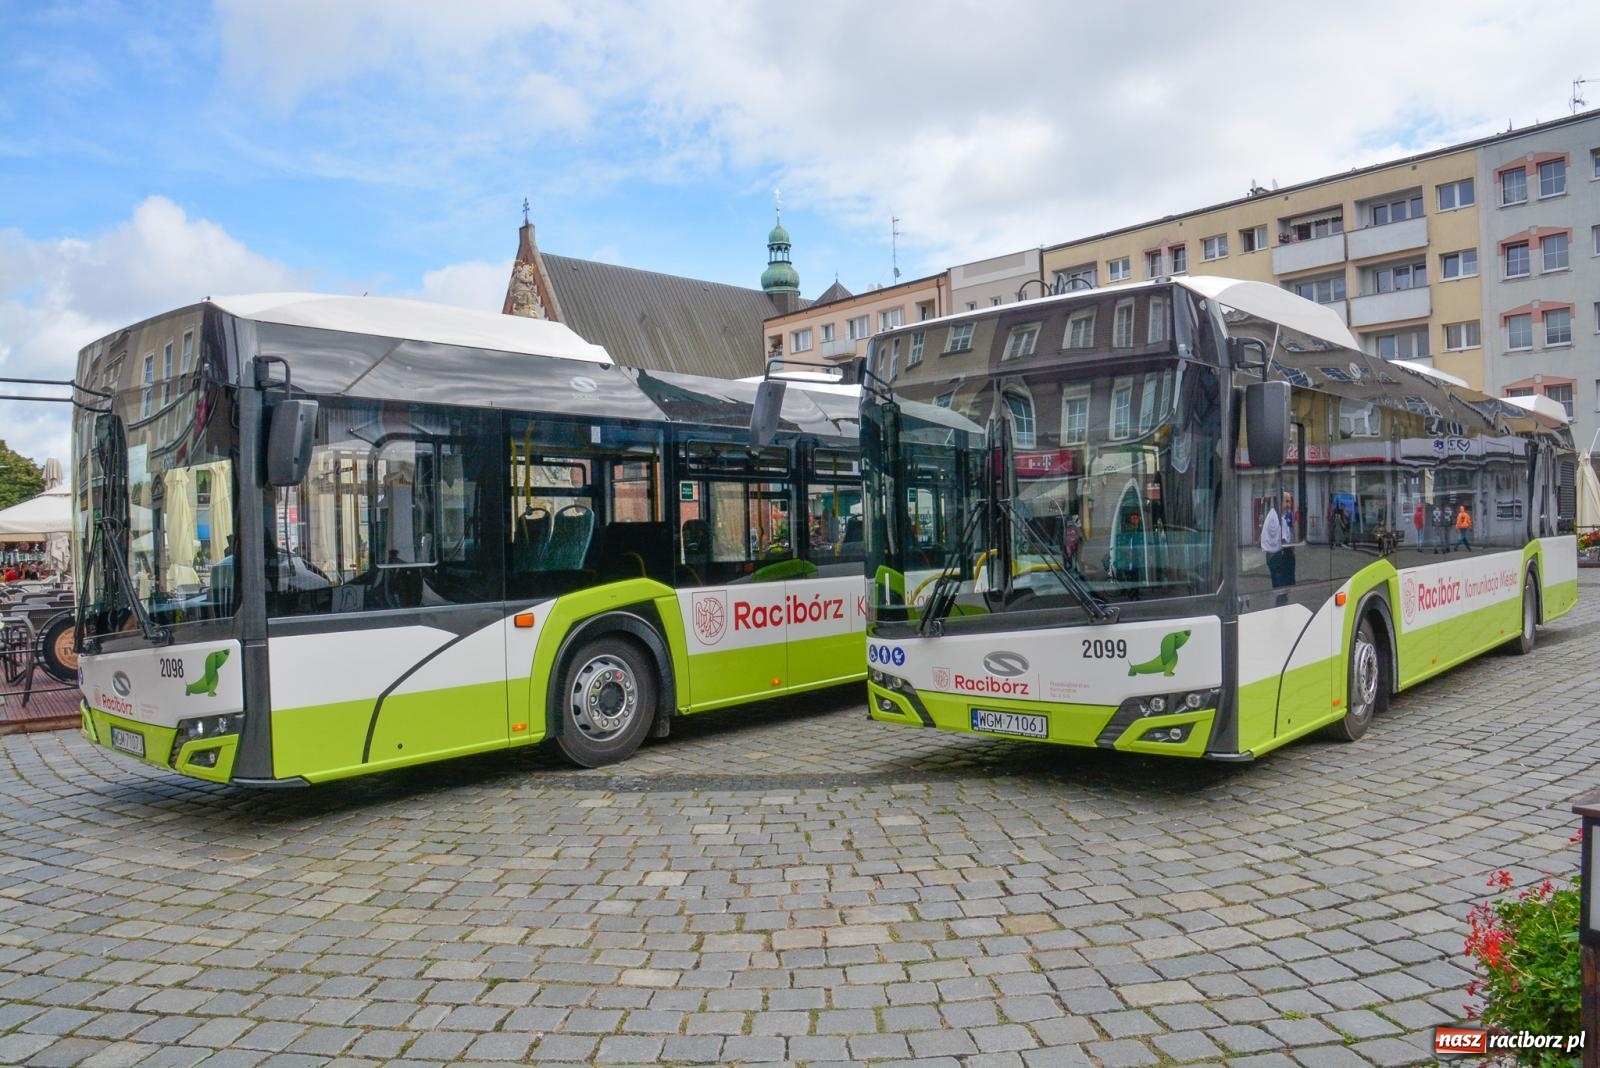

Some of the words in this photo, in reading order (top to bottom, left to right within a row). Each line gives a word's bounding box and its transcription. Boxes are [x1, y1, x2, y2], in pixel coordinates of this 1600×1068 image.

[1418, 576, 1460, 611] Racibórz
[733, 593, 844, 631] Racibórz
[1081, 639, 1127, 659] 2099
[159, 658, 184, 678] 2098
[954, 673, 1029, 695] Racibórz
[101, 693, 133, 715] Racibórz
[978, 711, 1003, 728] WGM
[1006, 714, 1044, 733] 7106J
